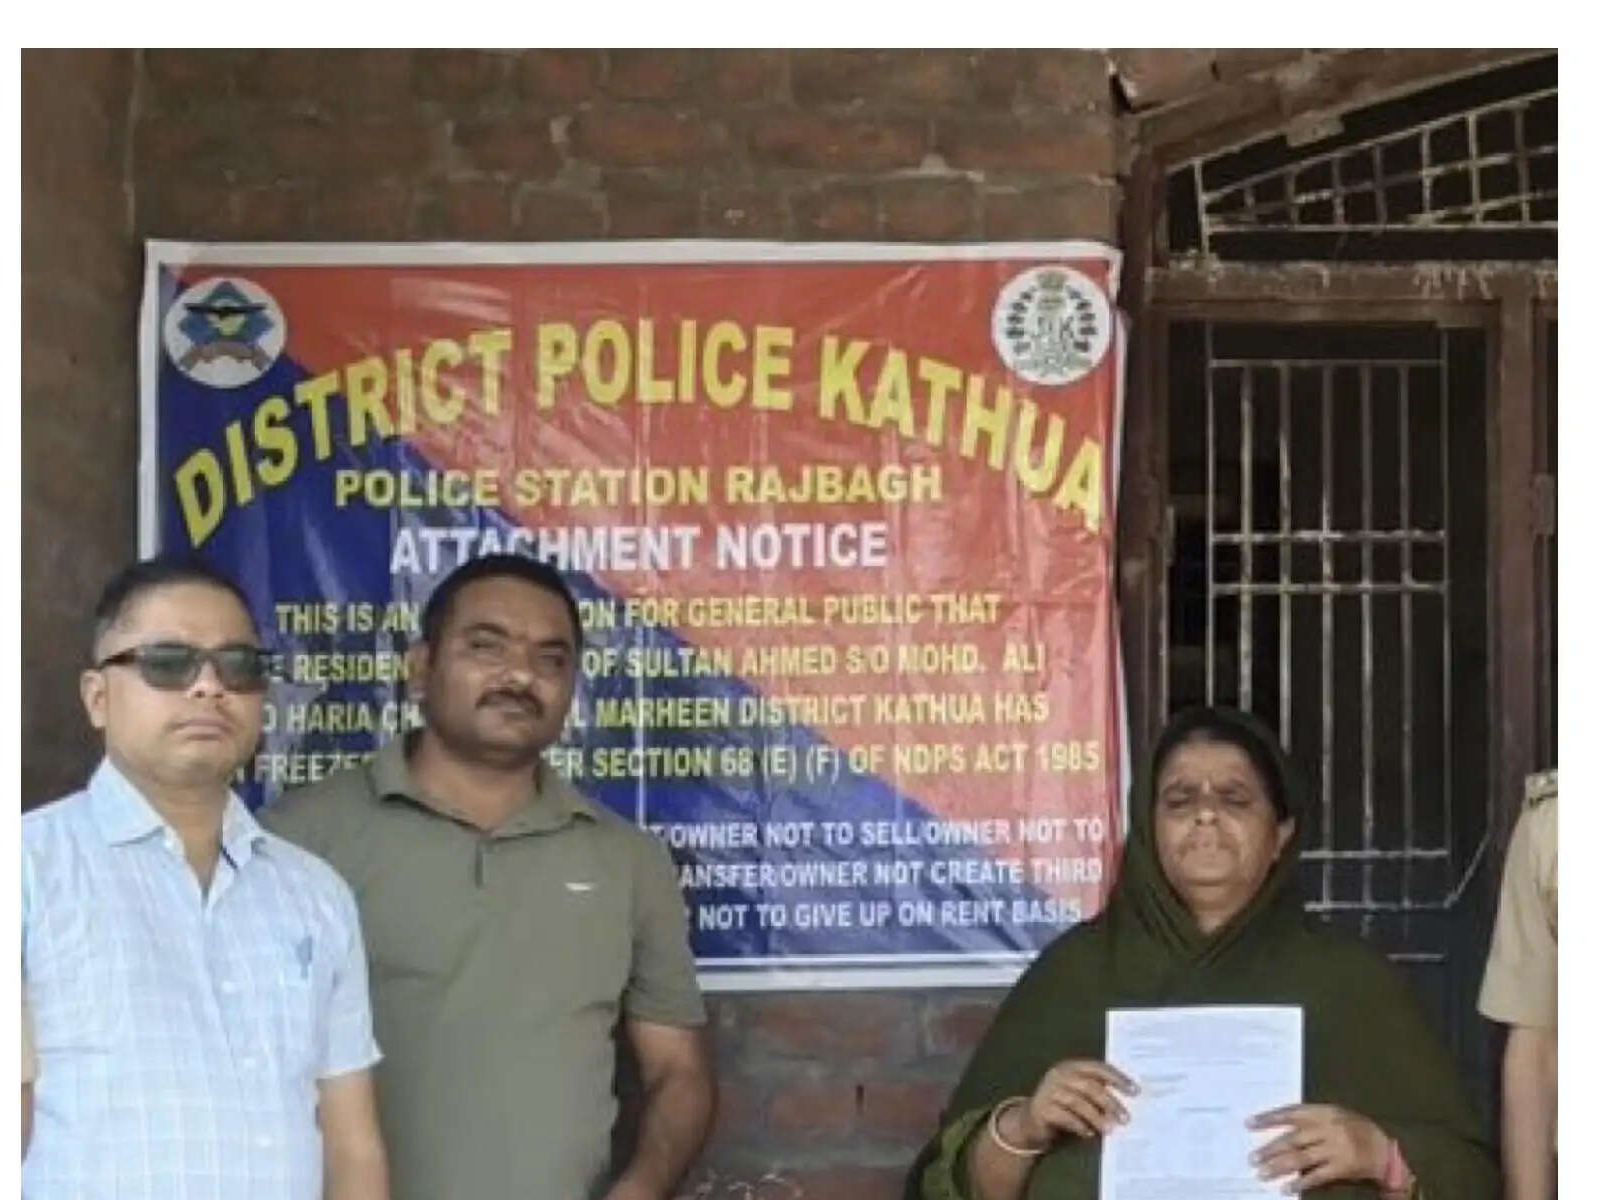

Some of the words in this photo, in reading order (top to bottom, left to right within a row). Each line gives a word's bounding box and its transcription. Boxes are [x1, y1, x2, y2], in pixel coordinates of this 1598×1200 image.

[174, 327, 513, 548] DISTRICT
[536, 317, 795, 411] POLICE
[819, 334, 1103, 534] KATHUA
[334, 467, 499, 508] POLICE
[514, 466, 710, 507] STATION
[726, 464, 943, 504] RAJBAGH
[389, 524, 702, 574] ATTACHMENT
[716, 521, 890, 572] NOTICE
[275, 601, 340, 635] THIS
[346, 601, 375, 634] IS
[380, 601, 422, 635] AN
[624, 597, 682, 630] FOR
[687, 595, 815, 628] GENERAL
[822, 593, 925, 626] PUBLIC
[930, 592, 1003, 625] THAT
[293, 652, 409, 685] RESIDEN
[581, 647, 621, 680] OF
[626, 646, 734, 679] SULTAN
[740, 644, 836, 677] AHMED
[1001, 641, 1048, 674] ALI
[287, 701, 373, 733] HARIA
[594, 696, 730, 729] MARHEEN
[738, 695, 868, 728] DISTRICT
[873, 693, 987, 725] KATHUA
[993, 692, 1051, 724] HAS
[591, 746, 714, 778] SECTION
[762, 746, 797, 783] (E)
[804, 745, 841, 785] (F)
[848, 743, 887, 775] OF
[894, 742, 966, 774] NDPS
[973, 741, 1030, 774] ACT
[1036, 739, 1102, 772] 1985
[765, 820, 815, 848] NOT
[819, 820, 855, 847] TO
[1017, 818, 1067, 844] NOT
[1073, 817, 1105, 842] TO
[873, 860, 925, 887] NOT
[930, 858, 1025, 886] CREATE
[1031, 856, 1105, 885] THIRD
[697, 901, 748, 931] NOT
[755, 901, 787, 929] TO
[793, 901, 852, 929] GIVE
[858, 899, 893, 928] UP
[898, 899, 934, 926] ON
[939, 898, 1006, 927] RENT
[1011, 897, 1083, 924] BASIS
